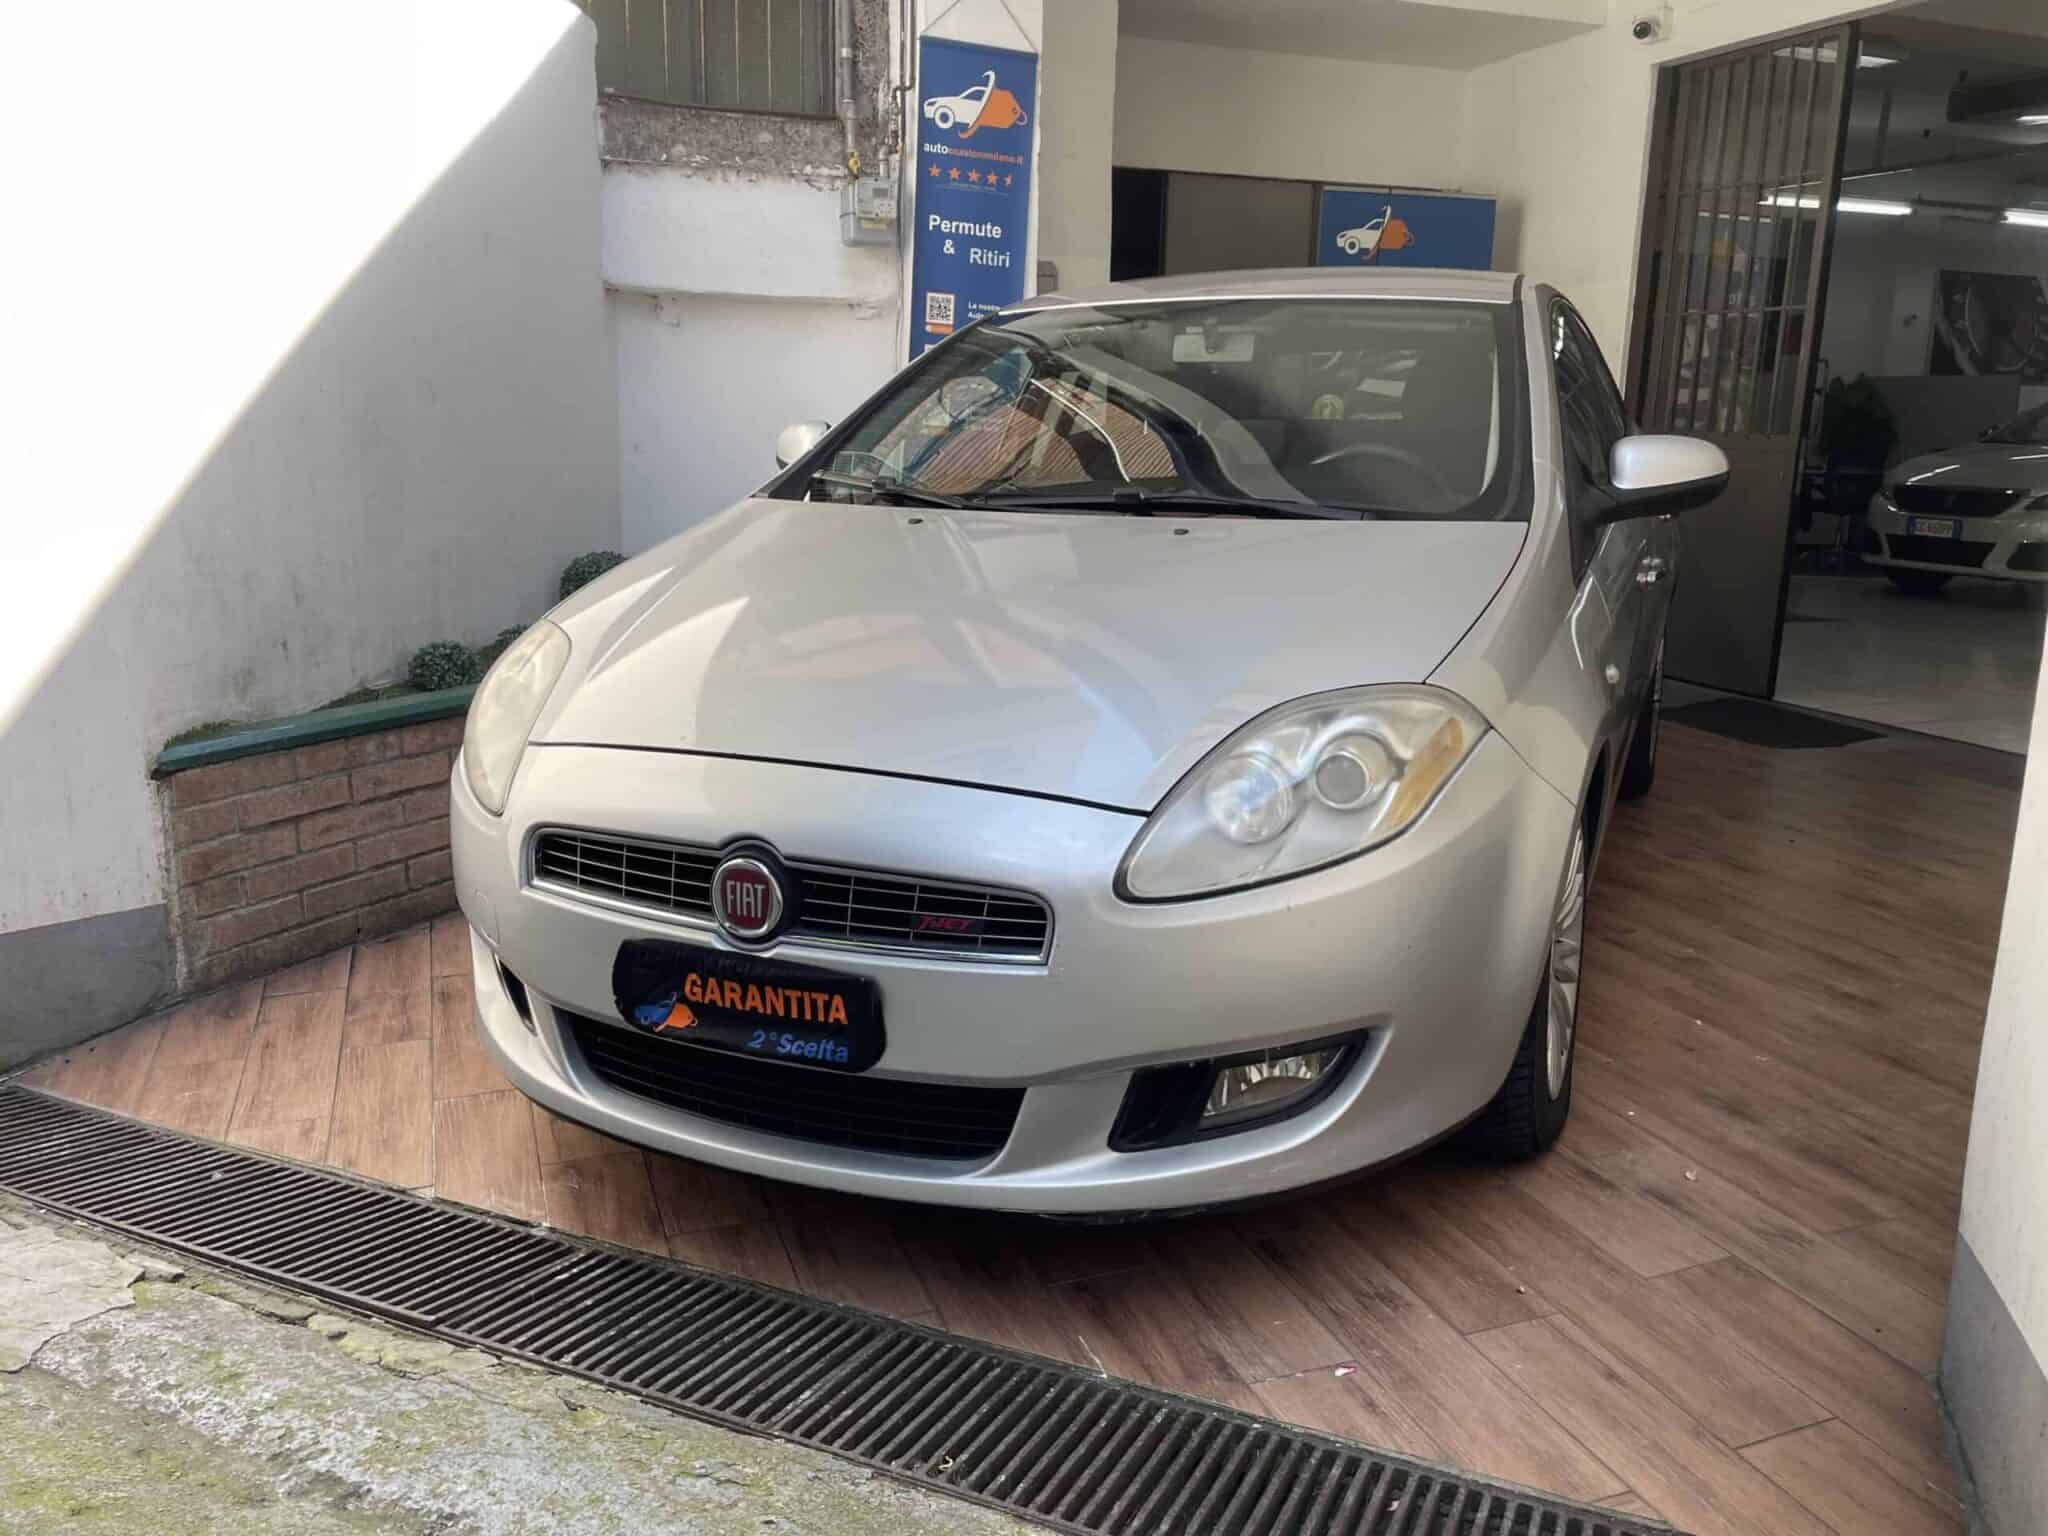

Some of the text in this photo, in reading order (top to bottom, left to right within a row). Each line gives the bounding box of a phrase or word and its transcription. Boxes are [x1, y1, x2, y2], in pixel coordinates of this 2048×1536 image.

[928, 214, 1002, 239] Permute
[943, 239, 1011, 268] & Ritiri
[726, 880, 766, 918] FIAT
[683, 973, 848, 1025] GARANTITA
